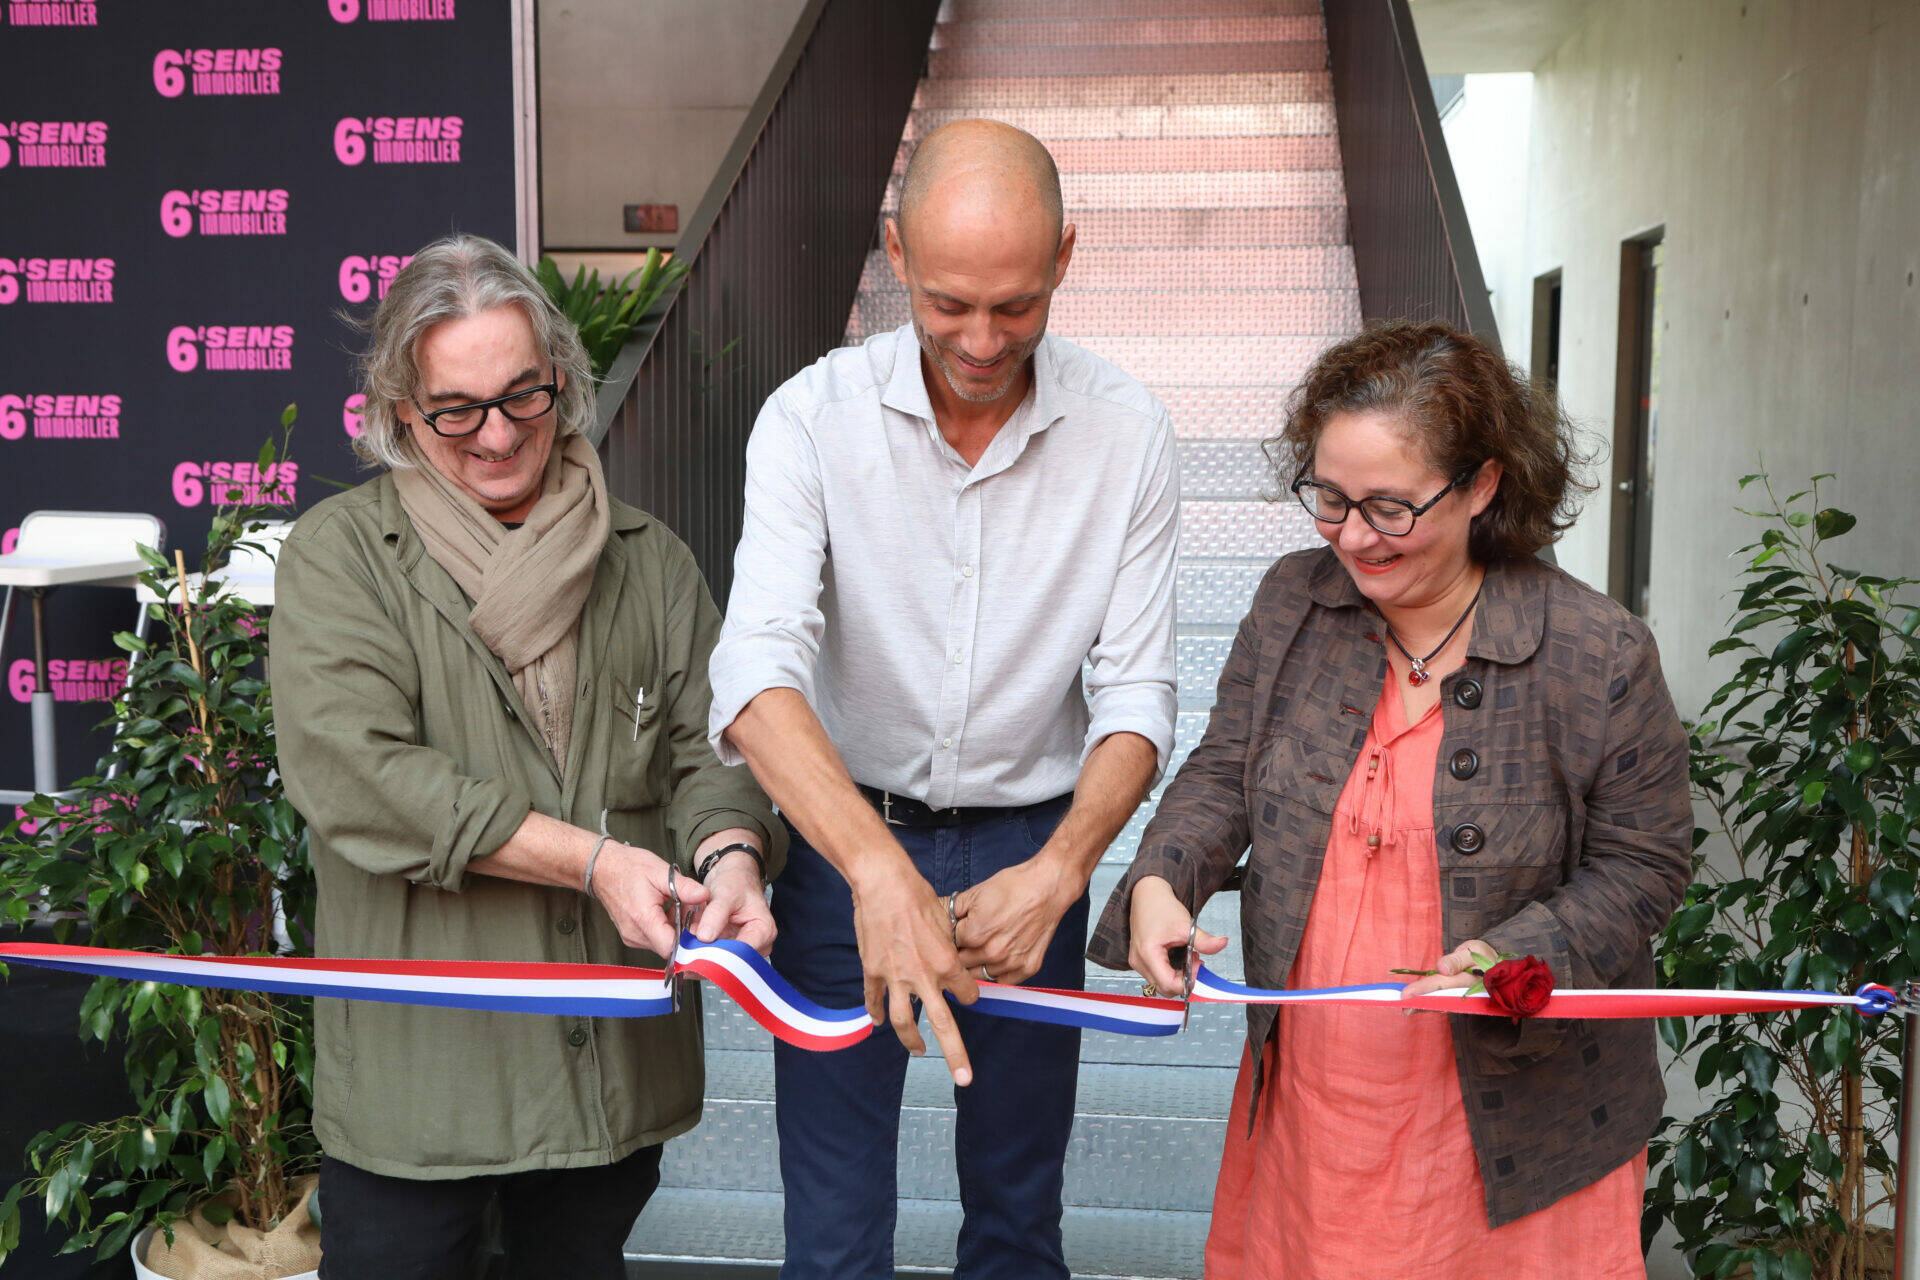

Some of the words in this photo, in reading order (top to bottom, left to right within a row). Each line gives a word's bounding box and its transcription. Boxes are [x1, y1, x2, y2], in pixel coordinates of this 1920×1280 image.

[9, 3, 98, 26] IMMOBILIER
[367, 0, 455, 21] IMMOBILIER
[192, 72, 281, 95] IMMOBILIER
[18, 144, 107, 167] IMMOBILIER
[373, 140, 461, 163] IMMOBILIER
[199, 212, 287, 235] IMMOBILIER
[26, 280, 114, 303] IMMOBILIER
[205, 348, 292, 370] IMMOBILIER
[33, 417, 120, 439] IMMOBILIER
[51, 681, 126, 702] MMOBILIE
